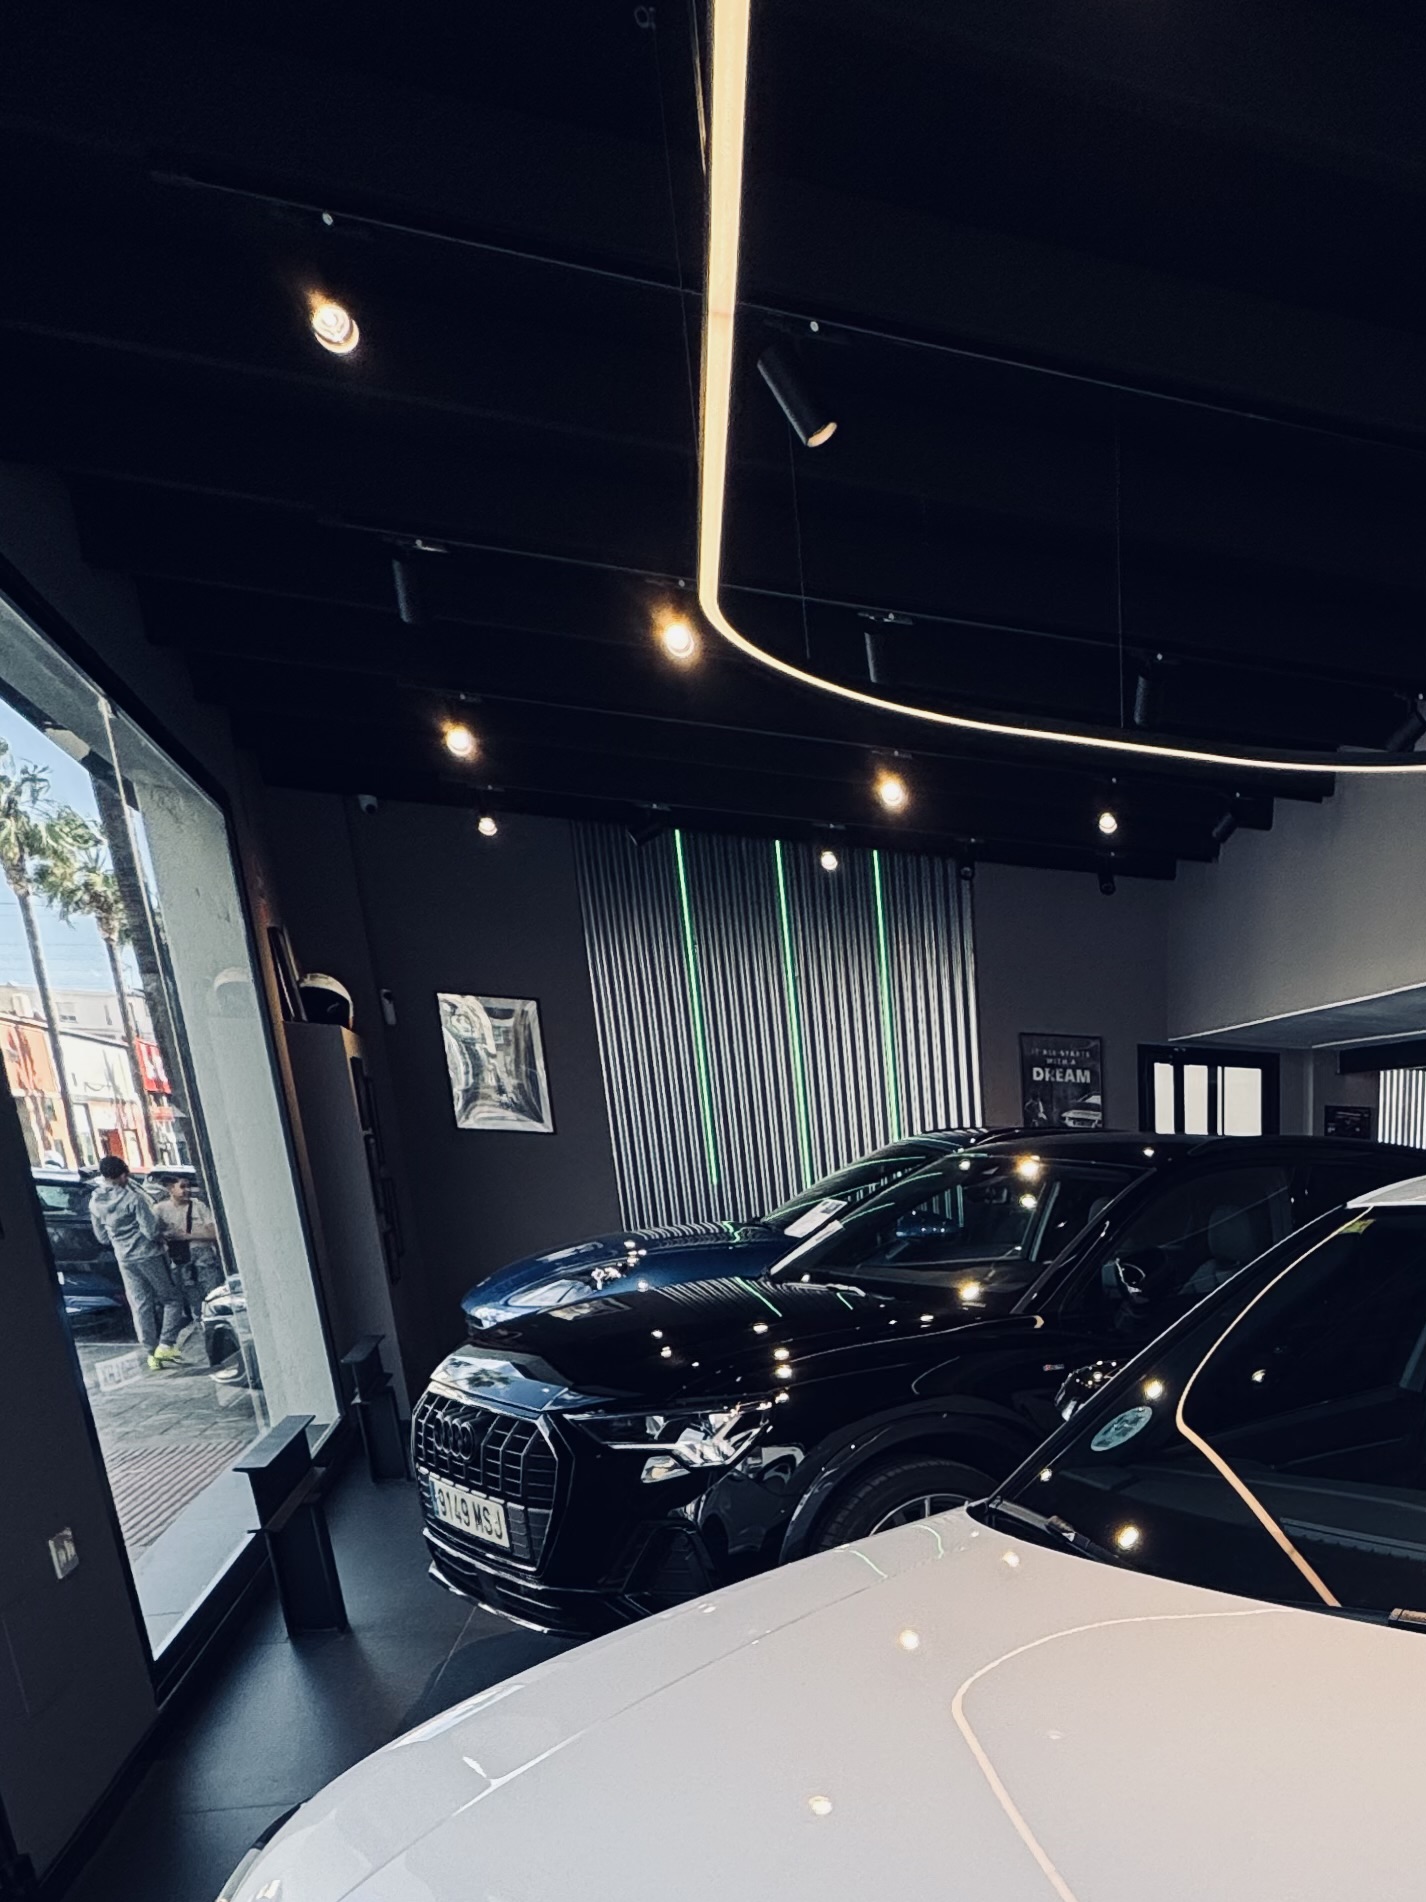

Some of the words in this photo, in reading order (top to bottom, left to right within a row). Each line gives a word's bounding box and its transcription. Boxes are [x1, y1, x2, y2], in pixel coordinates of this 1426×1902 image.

[1032, 1067, 1090, 1083] DREAM
[438, 1489, 470, 1527] 9149
[473, 1502, 503, 1539] MSJ
